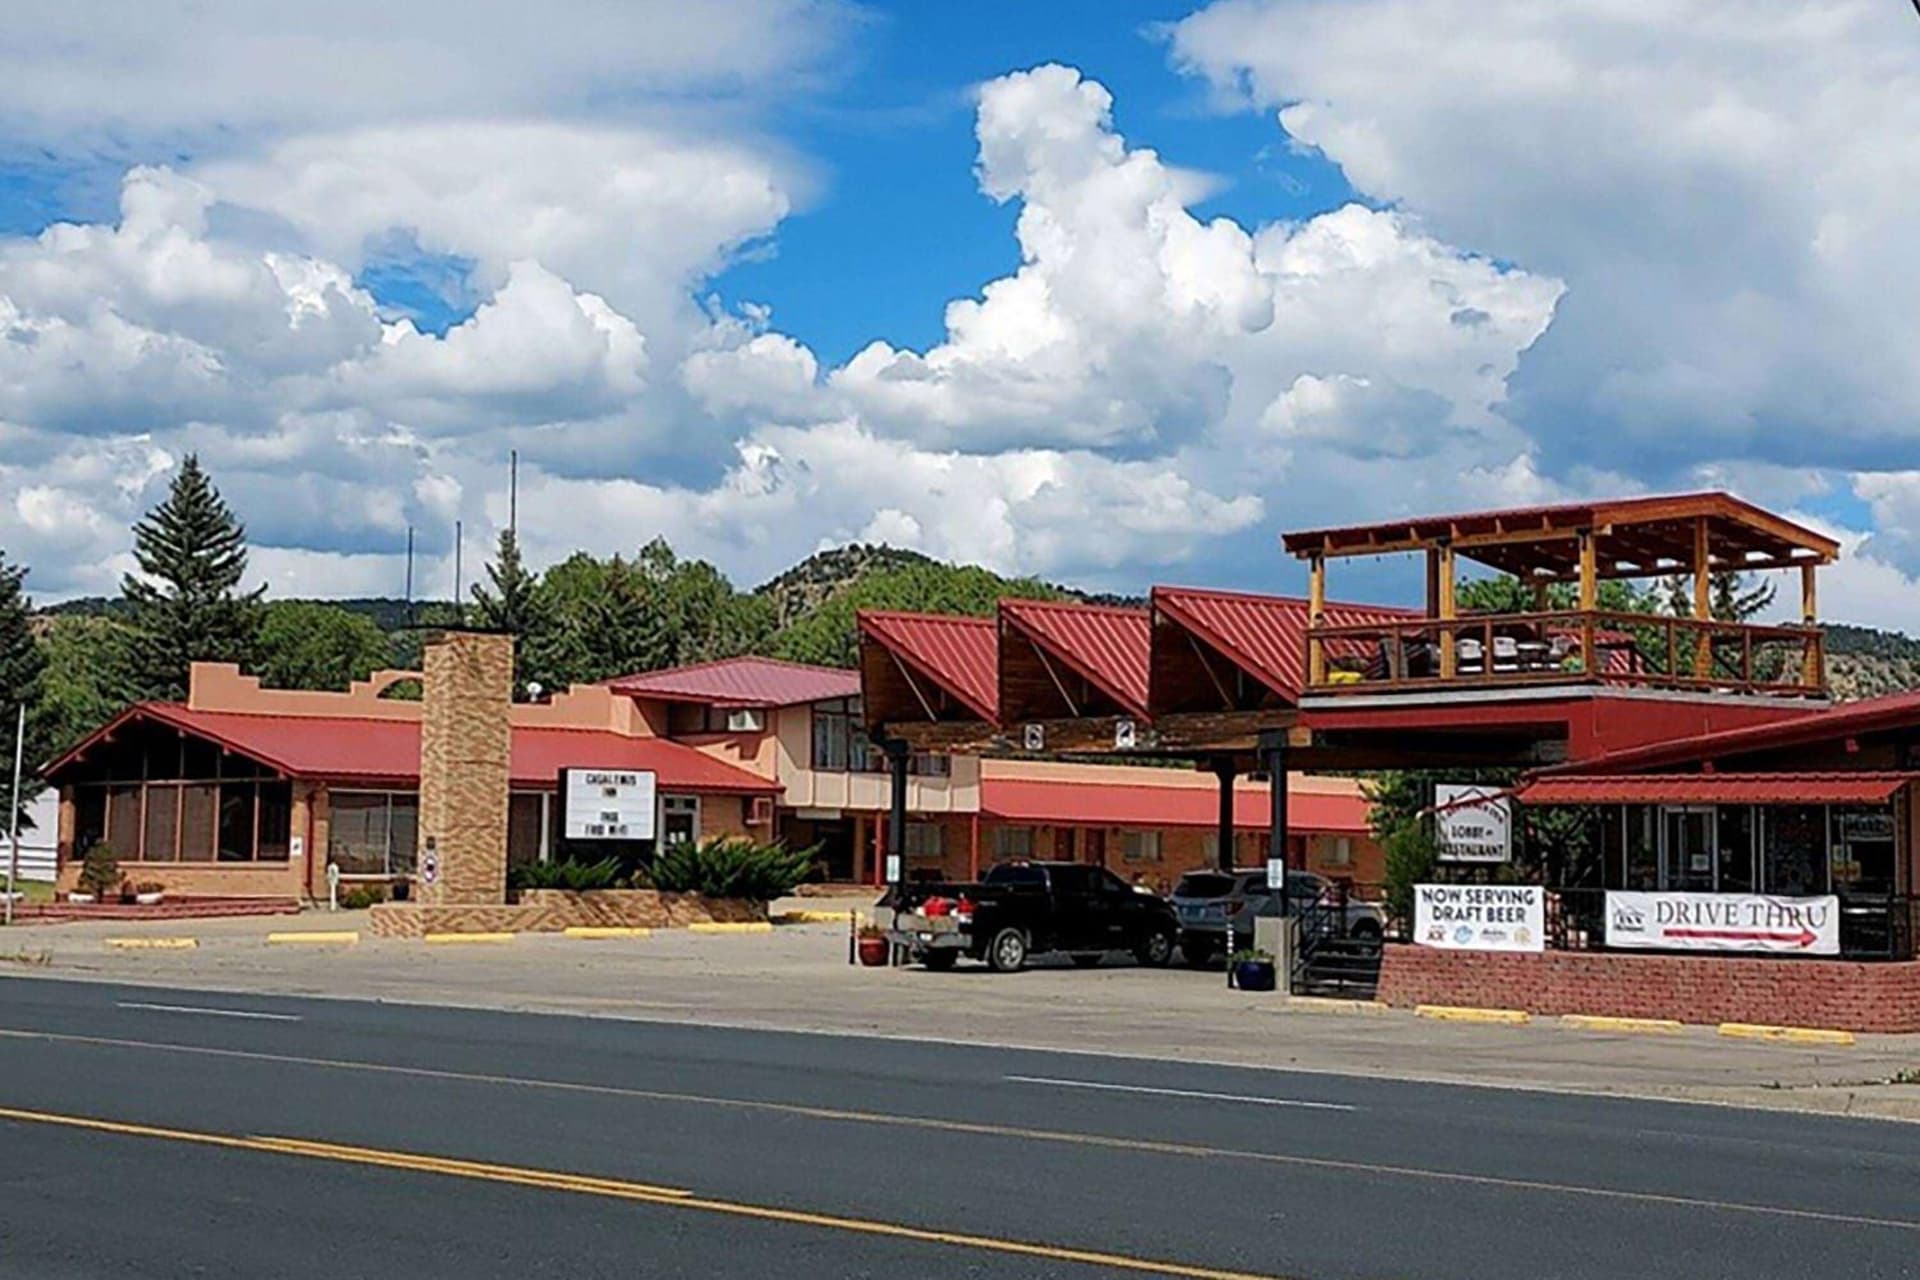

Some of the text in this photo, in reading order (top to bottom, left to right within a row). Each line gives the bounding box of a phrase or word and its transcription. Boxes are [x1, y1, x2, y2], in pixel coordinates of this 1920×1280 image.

[1451, 825, 1484, 838] LOBBY
[1422, 888, 1535, 906] NOW SERVING
[1432, 905, 1526, 922] DRAFT BEER
[1656, 901, 1828, 928] DRIVE THRU
